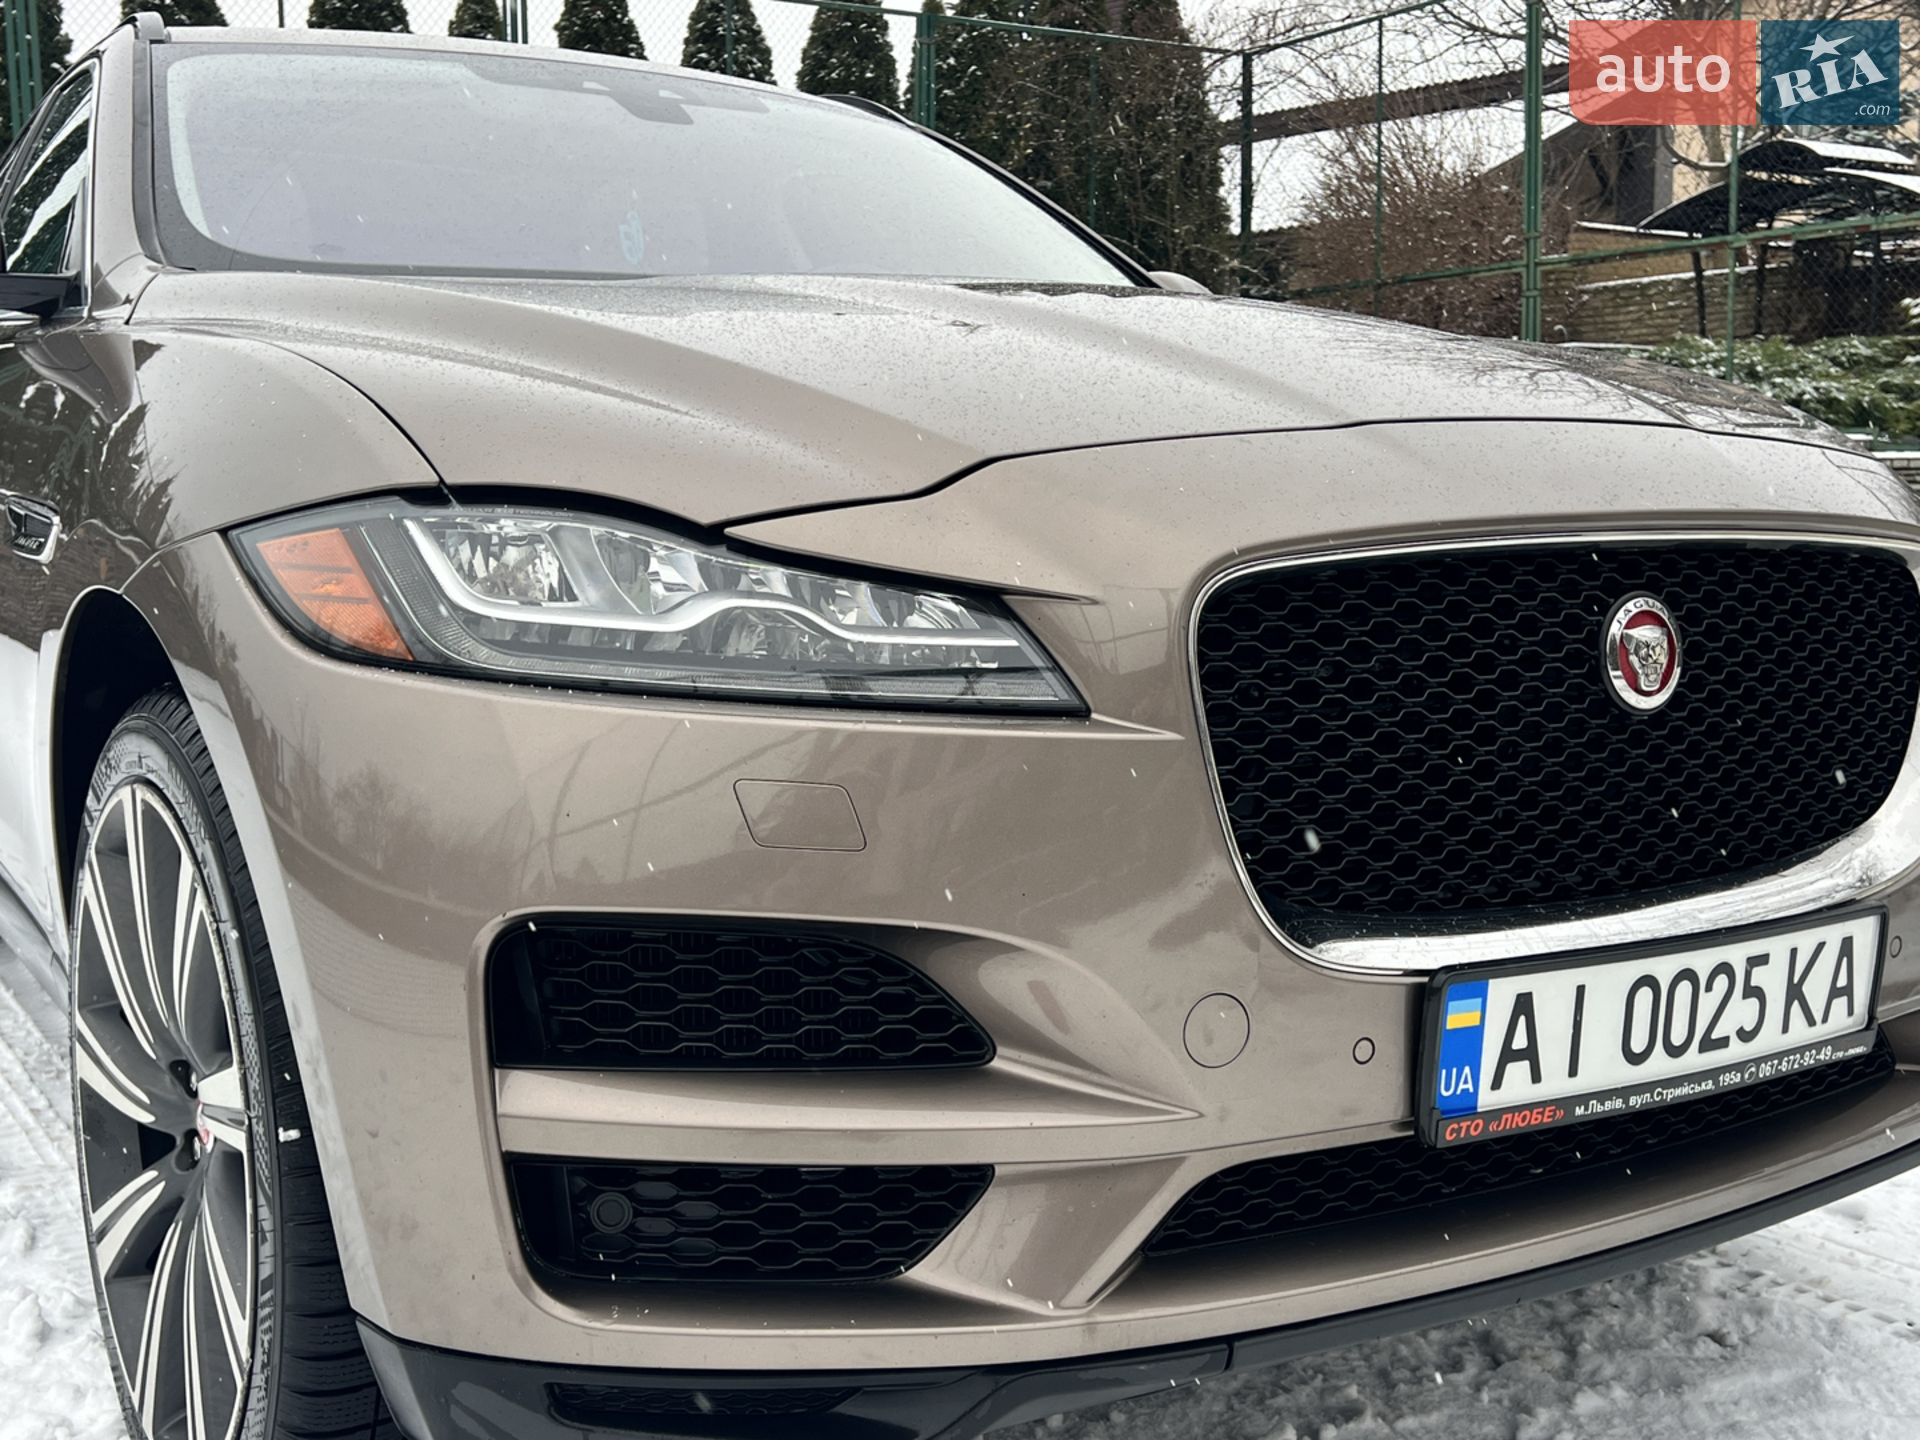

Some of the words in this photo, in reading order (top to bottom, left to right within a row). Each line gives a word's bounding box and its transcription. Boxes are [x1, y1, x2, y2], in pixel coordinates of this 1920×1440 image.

[1621, 952, 1770, 1066] 0025
[1440, 1066, 1474, 1097] UA
[1445, 1118, 1484, 1142] СТО
[1488, 1105, 1566, 1133] «ЛЮБЕ»
[1574, 1095, 1626, 1117] м.Львів,
[1718, 1074, 1742, 1088] 195а
[1758, 1045, 1832, 1079] 067-672-92-49
